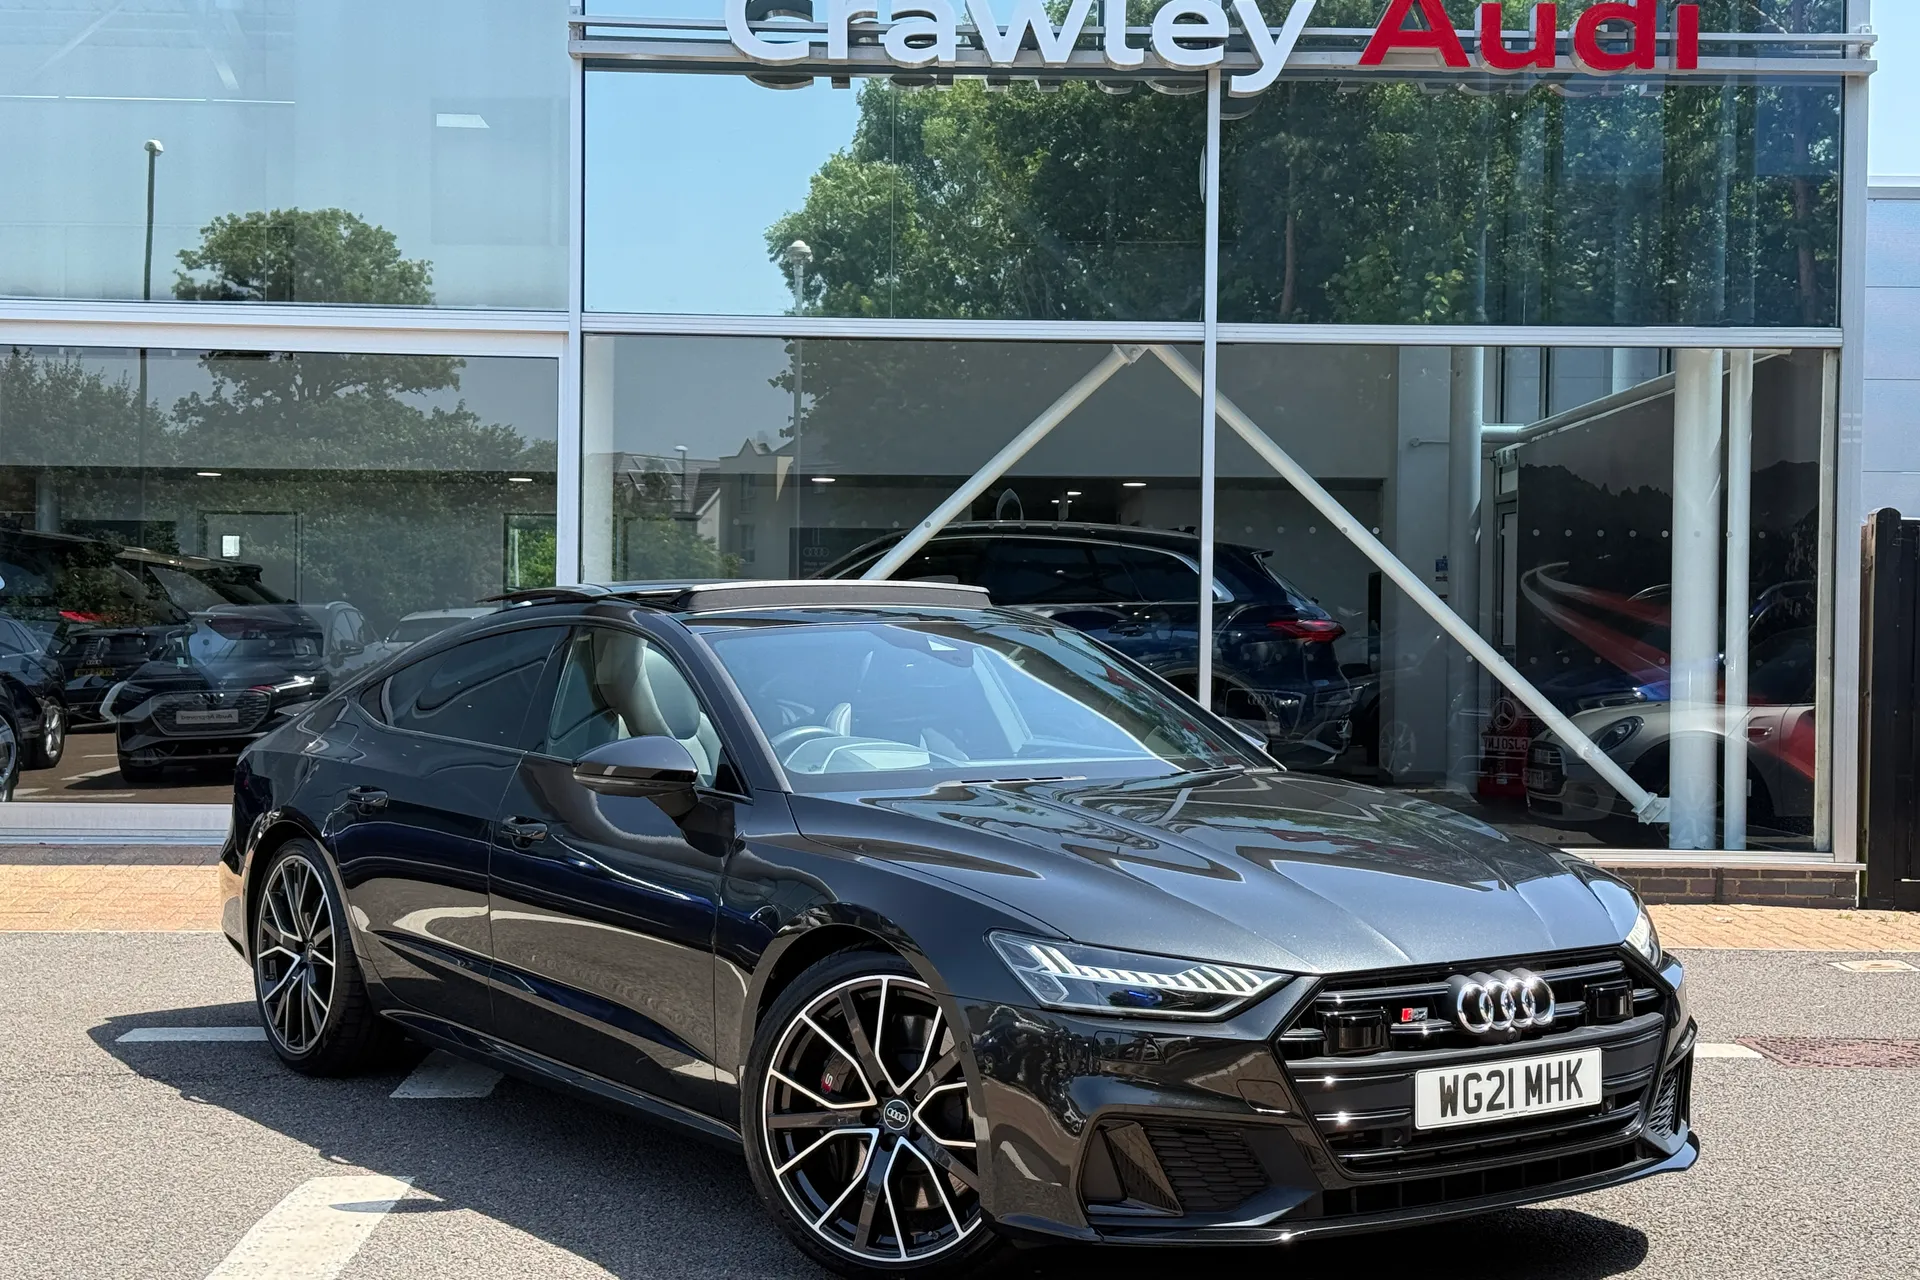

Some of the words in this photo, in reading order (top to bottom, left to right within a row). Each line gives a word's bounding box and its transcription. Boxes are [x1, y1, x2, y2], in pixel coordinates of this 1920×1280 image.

[725, 0, 1316, 94] Crawley
[1358, 0, 1699, 71] Audi
[1439, 1067, 1515, 1118] WG21
[1524, 1057, 1583, 1107] MHK
